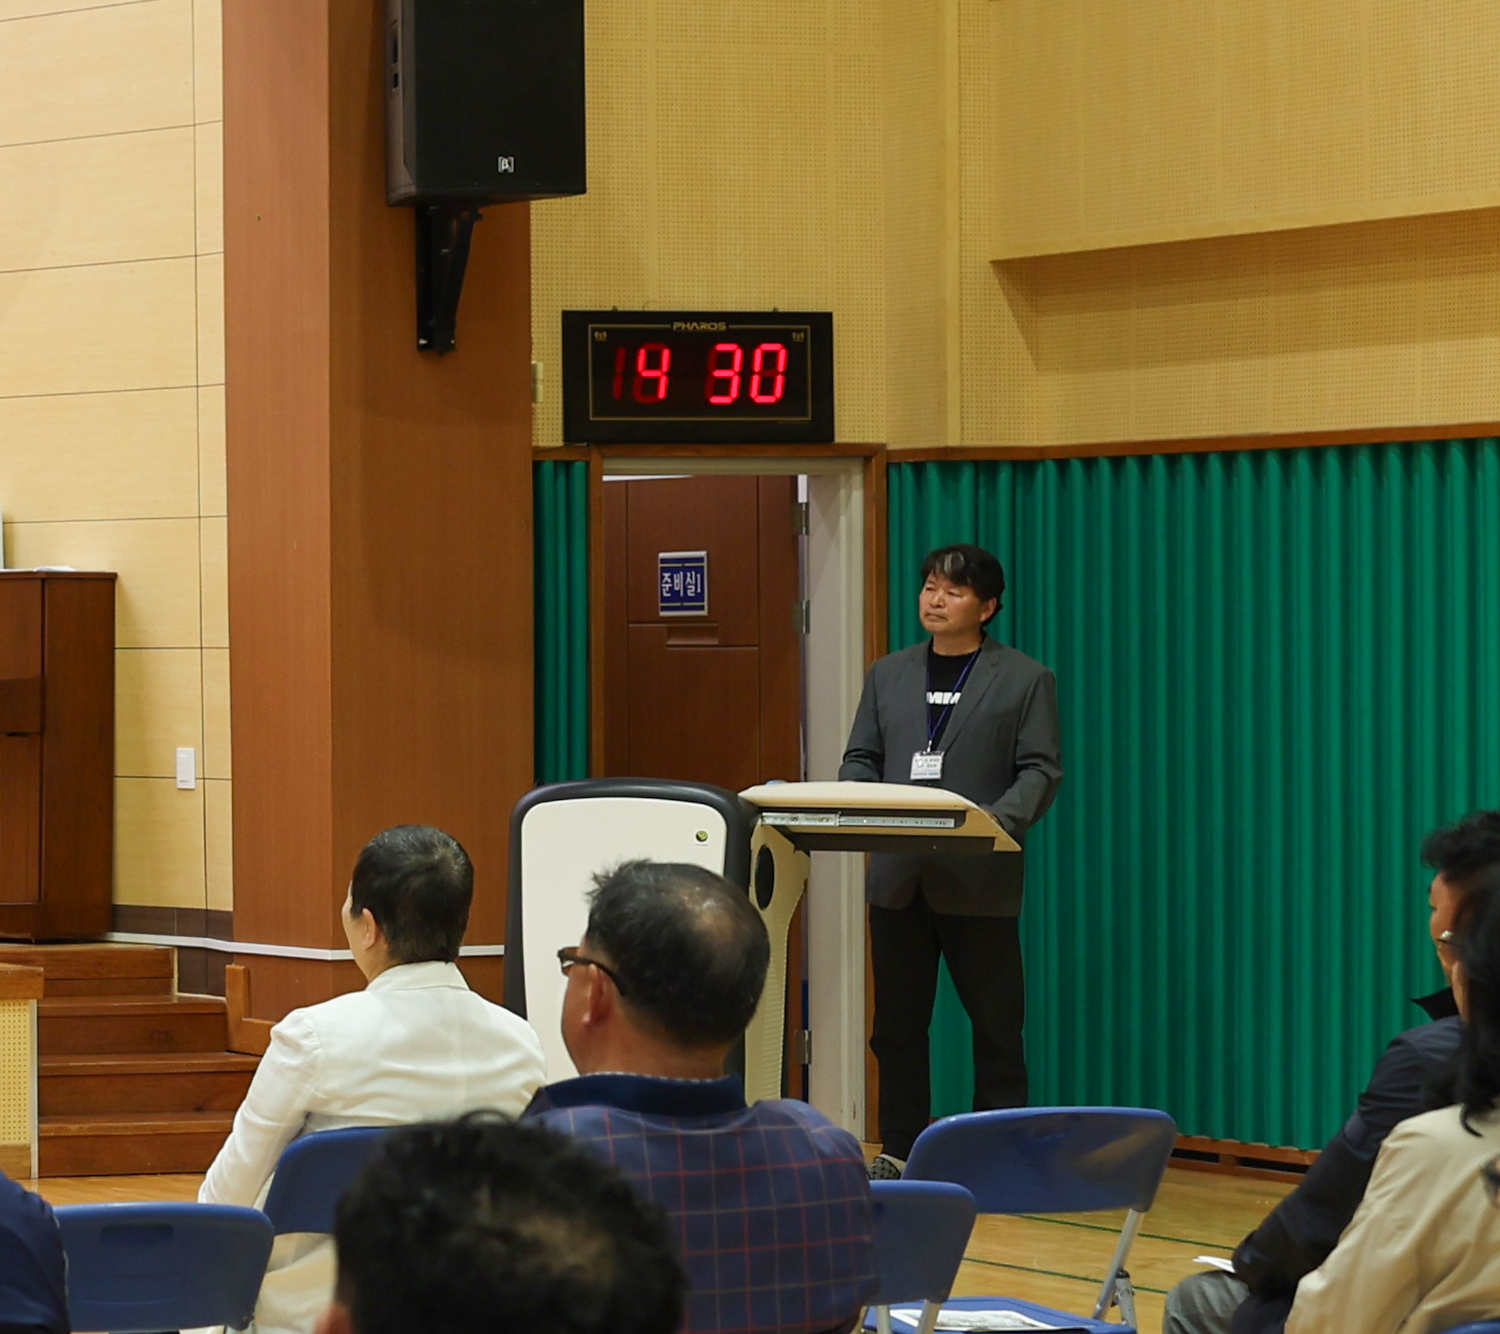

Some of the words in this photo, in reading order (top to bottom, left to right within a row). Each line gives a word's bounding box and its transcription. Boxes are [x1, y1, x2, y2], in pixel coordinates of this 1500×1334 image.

[671, 321, 727, 332] PHAROS
[707, 342, 788, 405] 30
[660, 570, 702, 598] 준비실1
